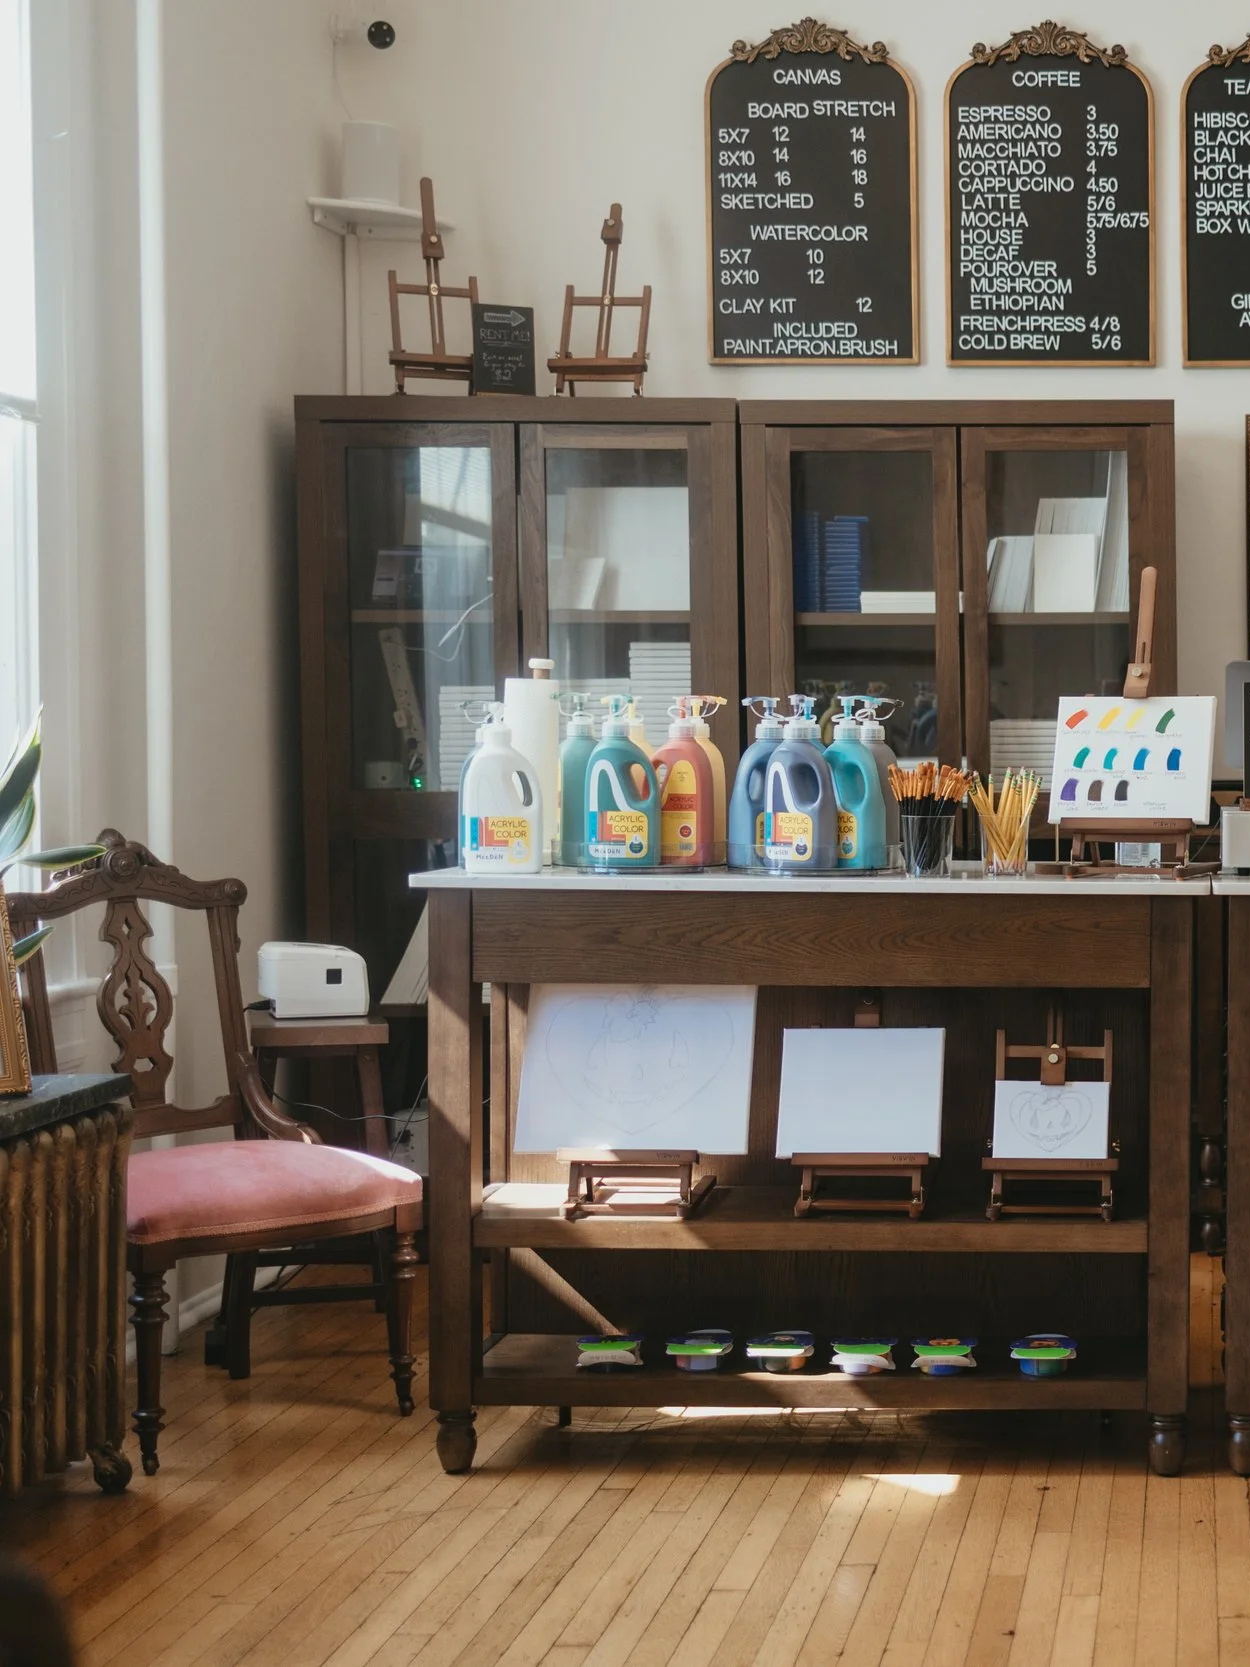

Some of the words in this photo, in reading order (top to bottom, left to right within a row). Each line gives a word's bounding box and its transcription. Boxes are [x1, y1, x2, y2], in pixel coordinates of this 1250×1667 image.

[774, 69, 841, 85] CANVAS
[1012, 71, 1080, 87] COFFEE
[748, 103, 809, 118] BOARD
[813, 101, 895, 117] STRETCH
[958, 106, 1050, 122] ESPRESSO
[1087, 106, 1096, 120] 3
[718, 128, 749, 144] 5X7
[772, 127, 789, 142] 12
[850, 127, 865, 142] 14
[958, 124, 1061, 140] AMERICANO
[1087, 124, 1118, 139] 3.50
[1195, 131, 1250, 146] BLACK
[719, 151, 754, 166] 8X10
[773, 149, 789, 163] 14
[851, 150, 866, 164] 16
[958, 142, 1061, 158] MACCHIATO
[1087, 142, 1117, 157] 3.75
[1194, 148, 1236, 163] CHAI
[959, 160, 1046, 175] CORTADO
[1087, 160, 1096, 174] 4
[1194, 165, 1226, 180] HOT
[718, 173, 757, 188] 11X14
[775, 172, 791, 186] 16
[852, 170, 867, 185] 18
[959, 177, 1074, 192] CAPPUCCINO
[1087, 178, 1118, 193] 4.50
[1195, 183, 1243, 198] JUICE
[721, 194, 813, 209] SKETCHED
[854, 194, 864, 208] 5
[962, 195, 1020, 209] LATTE
[1088, 196, 1115, 211] 5/6
[961, 212, 1028, 227] MOCHA
[1197, 219, 1232, 234] BOX
[750, 226, 868, 241] WATERCOLOR
[961, 229, 1023, 245] HOUSE
[1086, 229, 1096, 244] 3
[720, 249, 751, 264] 5X7
[806, 250, 824, 264] 10
[961, 246, 1019, 261] DECAF
[1086, 245, 1096, 259] 3
[961, 261, 1057, 277] POUROVER
[1087, 261, 1096, 276] 5
[721, 270, 759, 285] 8X10
[807, 270, 824, 284] 12
[971, 278, 1072, 293] MUSHROOM
[719, 299, 764, 314] CLAY
[770, 299, 796, 313] KIT
[856, 298, 872, 312] 12
[970, 295, 1064, 310] ETHIOPIAN
[774, 323, 857, 338] INCLUDED
[959, 335, 1006, 350] COLD
[1011, 336, 1059, 350] BREW
[1092, 335, 1121, 350] 5/6
